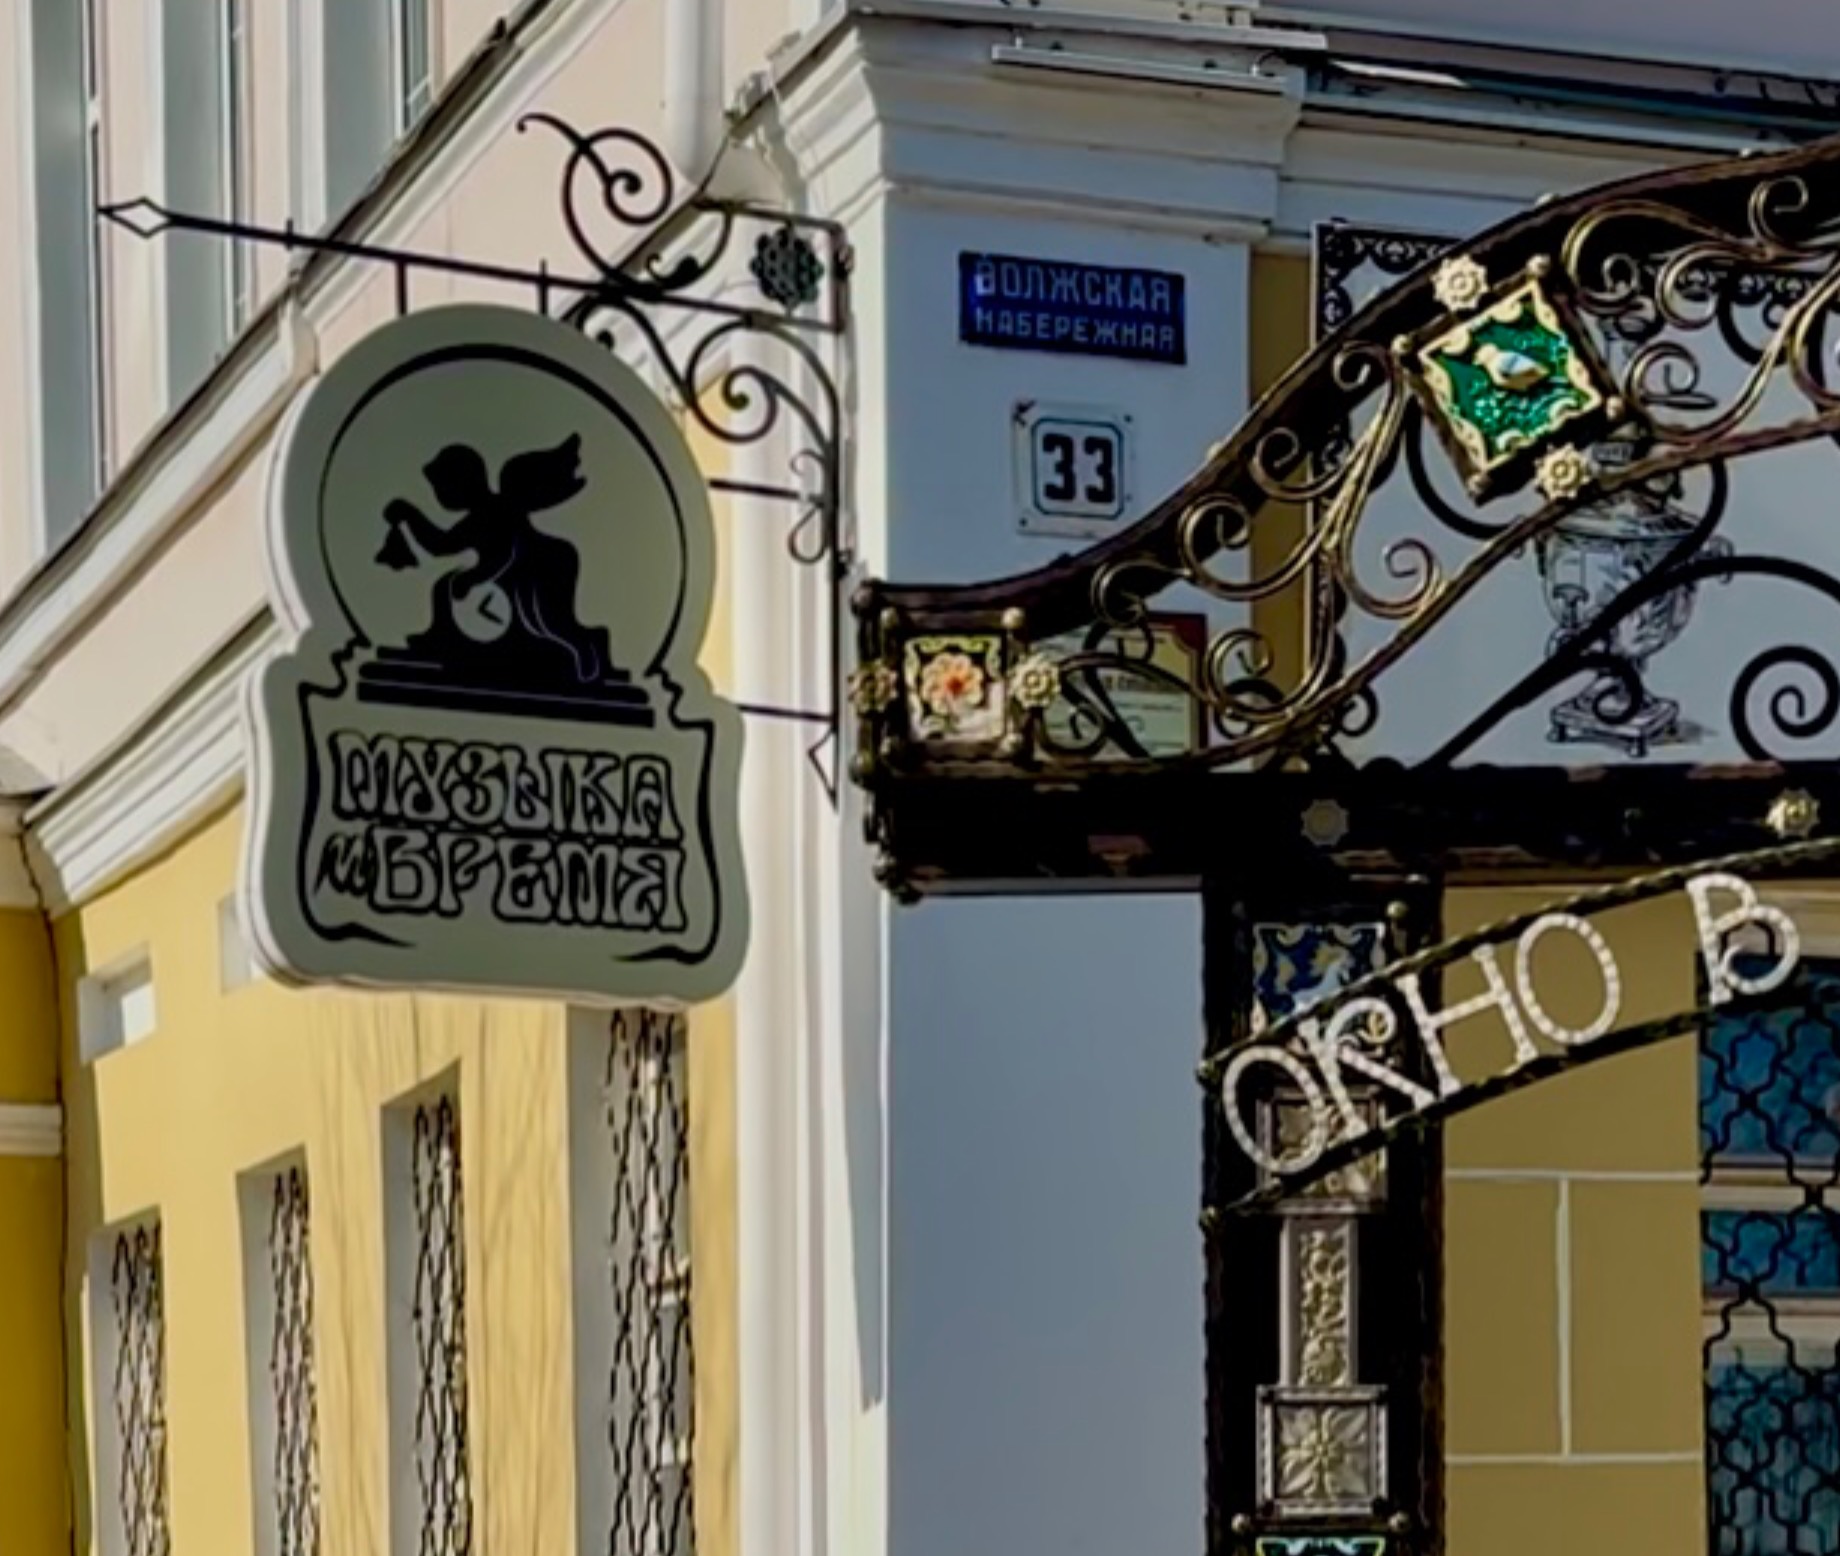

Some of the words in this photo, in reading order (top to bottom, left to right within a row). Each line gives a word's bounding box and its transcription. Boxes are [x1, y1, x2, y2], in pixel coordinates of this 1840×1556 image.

[974, 257, 1170, 314] ВОЛЖСКАЯ
[975, 306, 1176, 352] НАБЕРЕЖНАЯ
[1042, 432, 1115, 504] 33
[327, 730, 684, 849] МУЗЫКА
[367, 823, 688, 933] ВРЕМЯ
[1222, 912, 1620, 1174] ОКНО
[1685, 872, 1801, 1006] В
